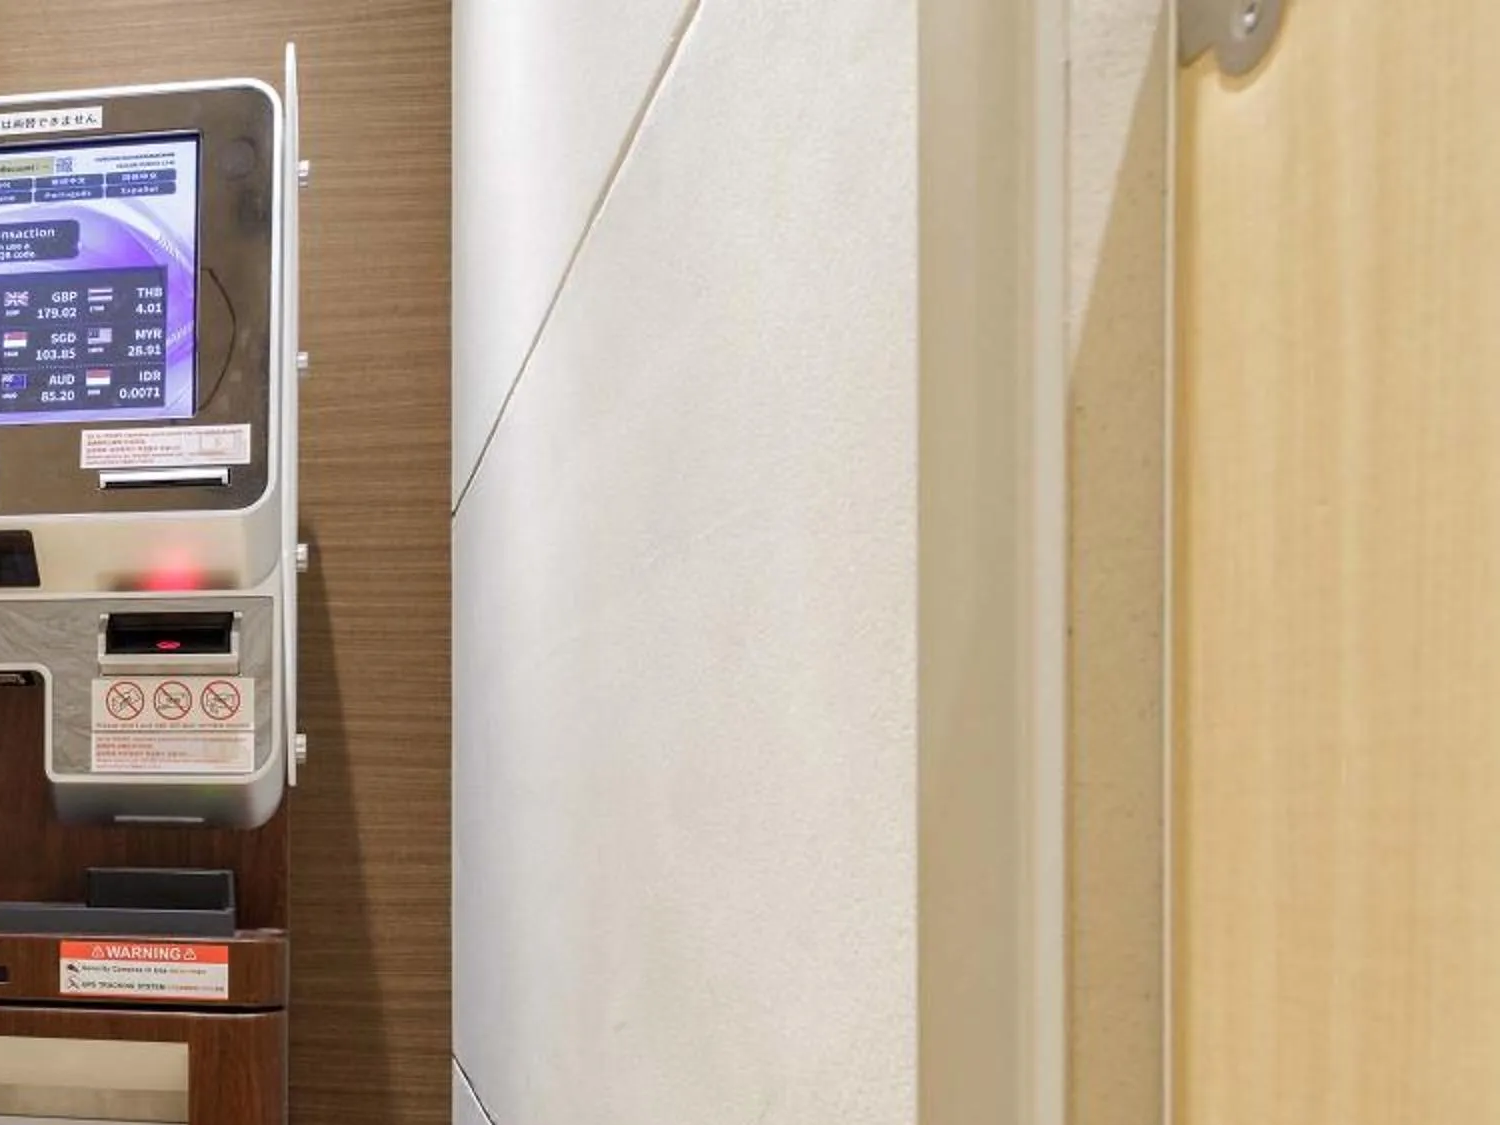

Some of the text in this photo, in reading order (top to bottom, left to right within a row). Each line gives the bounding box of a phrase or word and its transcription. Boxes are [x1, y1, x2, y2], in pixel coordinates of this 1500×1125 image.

[51, 291, 78, 303] GBP
[135, 286, 163, 298] THB
[135, 303, 163, 315] 4.01
[50, 332, 77, 344] SGD
[134, 328, 163, 340] MYR
[49, 374, 76, 386] AUD
[139, 370, 162, 382] IDR
[106, 945, 181, 961] WARNING
